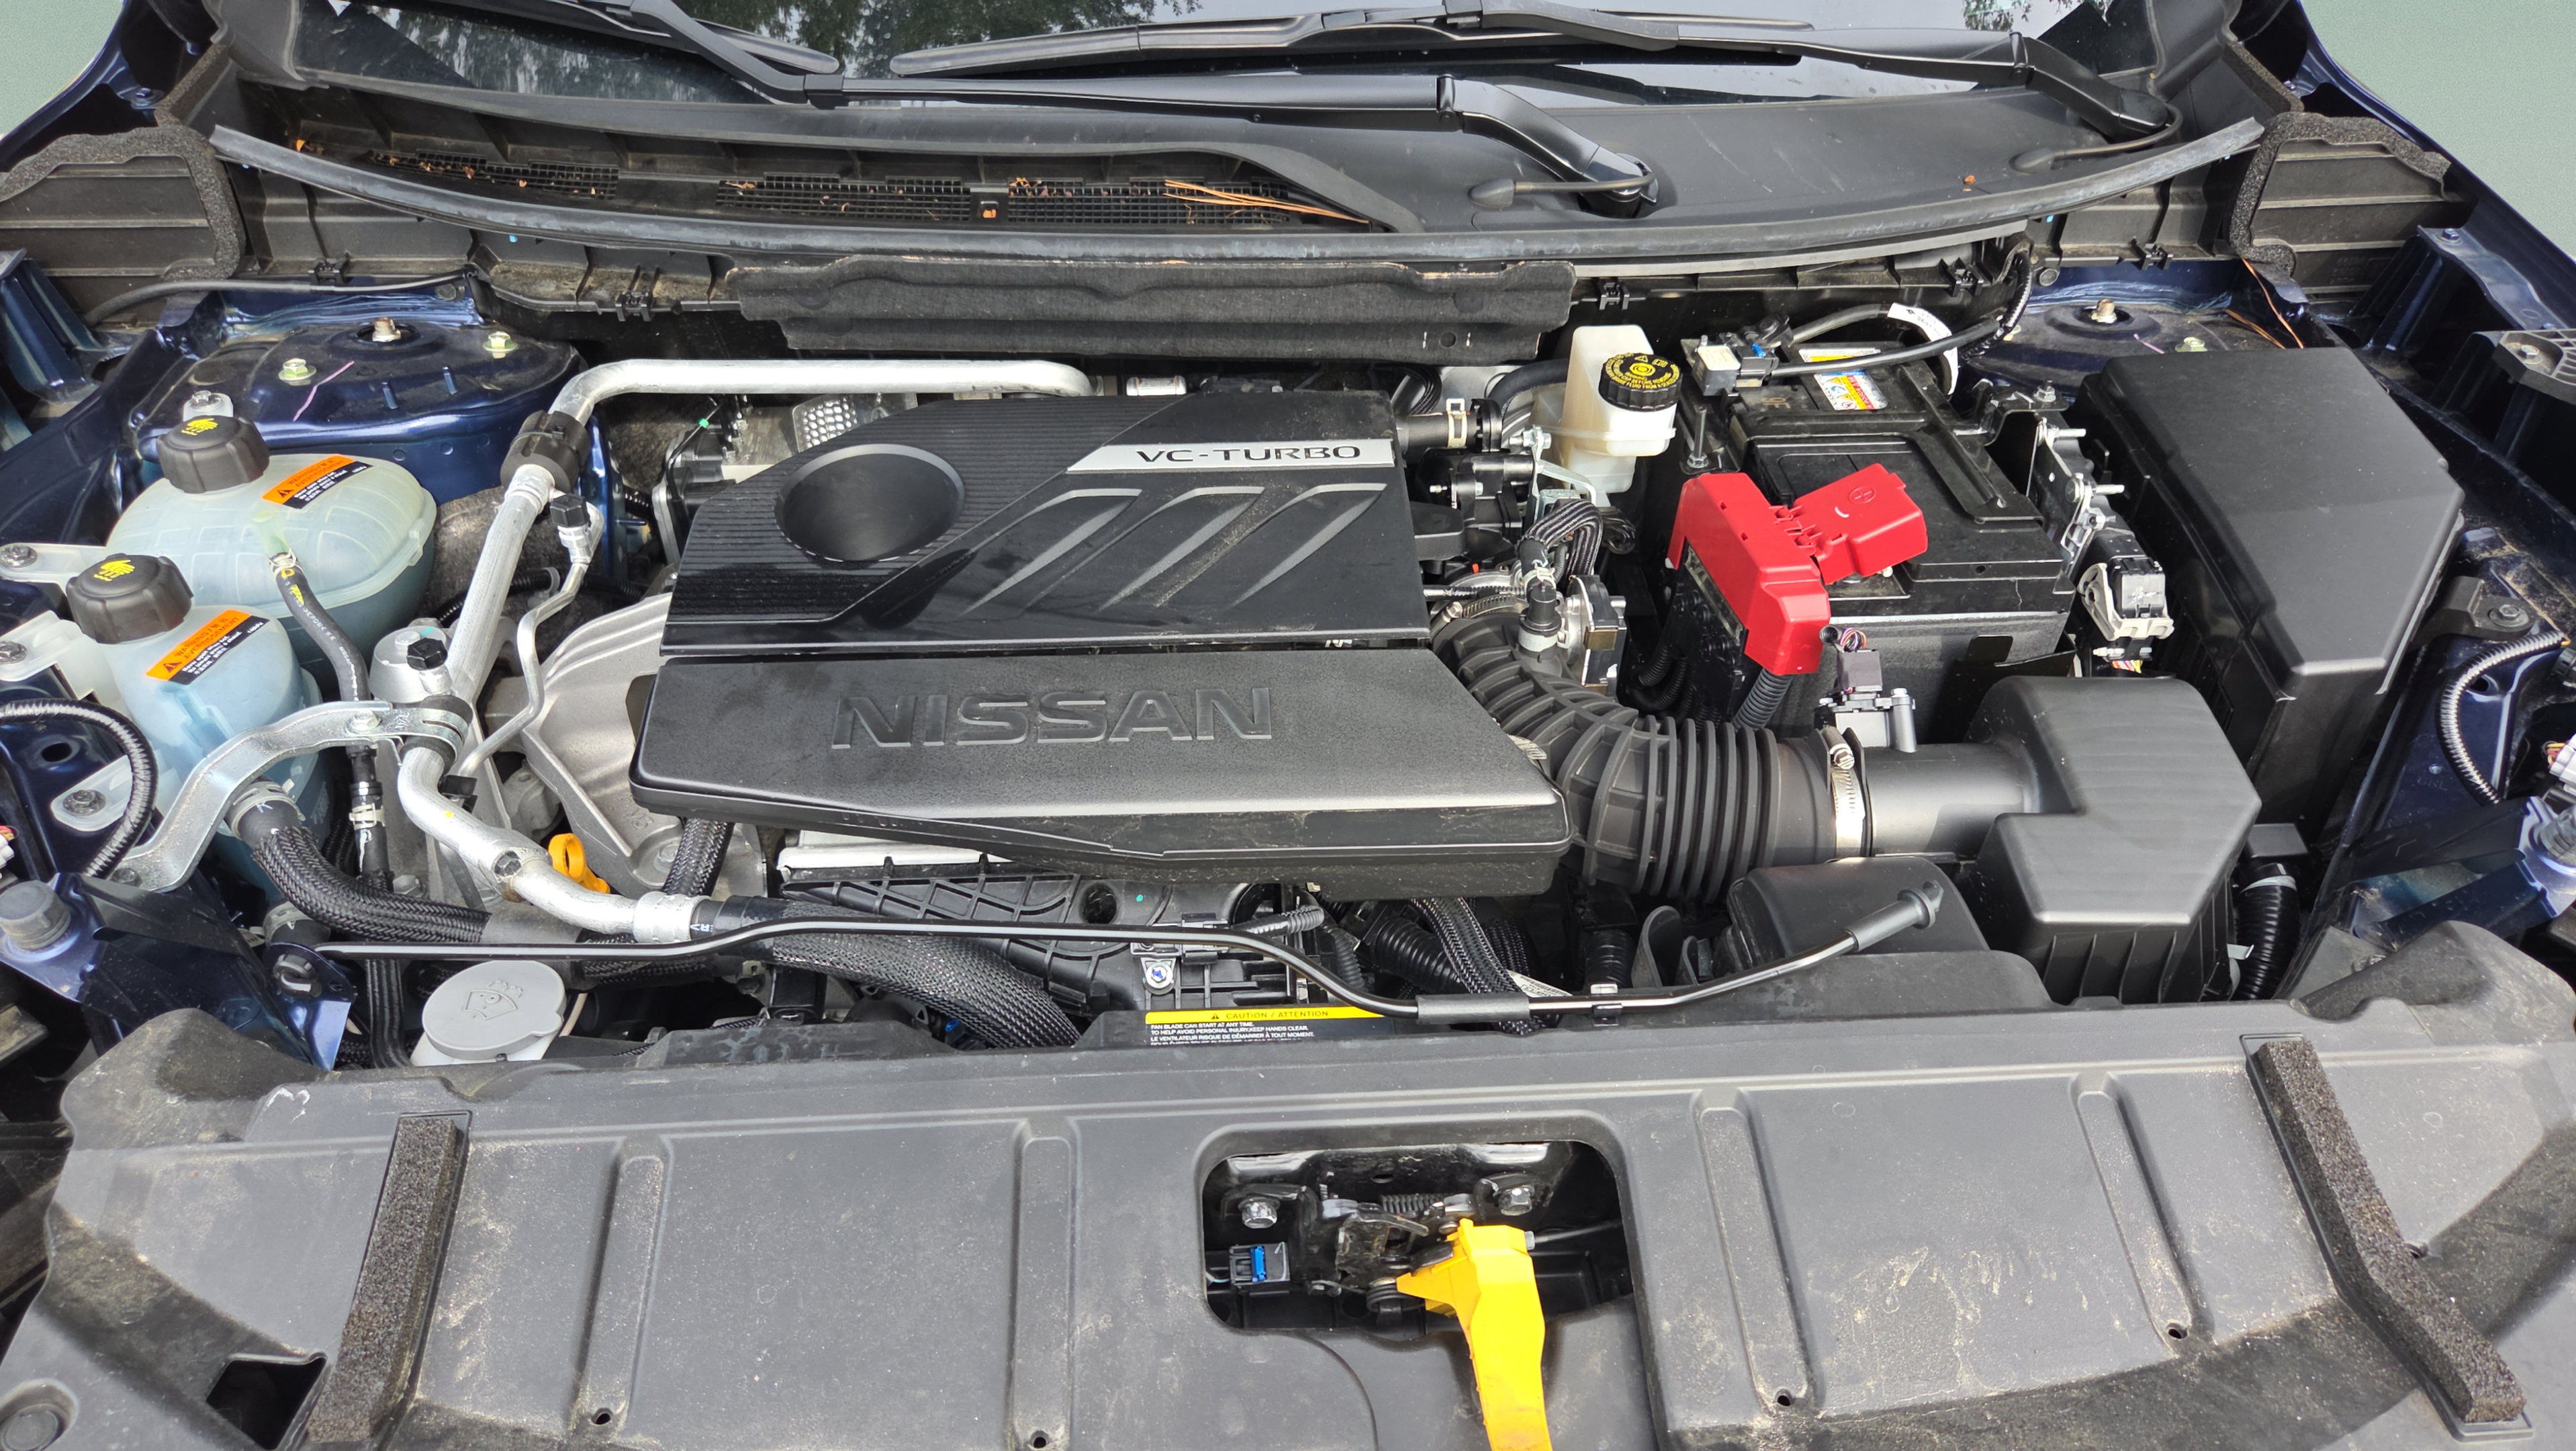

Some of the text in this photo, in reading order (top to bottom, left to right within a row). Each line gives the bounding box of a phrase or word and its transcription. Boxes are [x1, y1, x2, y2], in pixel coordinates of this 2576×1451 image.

[1136, 445, 1361, 463] VC-TURBO
[184, 617, 240, 659] AVERTISSEMENT
[831, 687, 1272, 750] NISSAN
[1226, 1012, 1267, 1020] CAUTION
